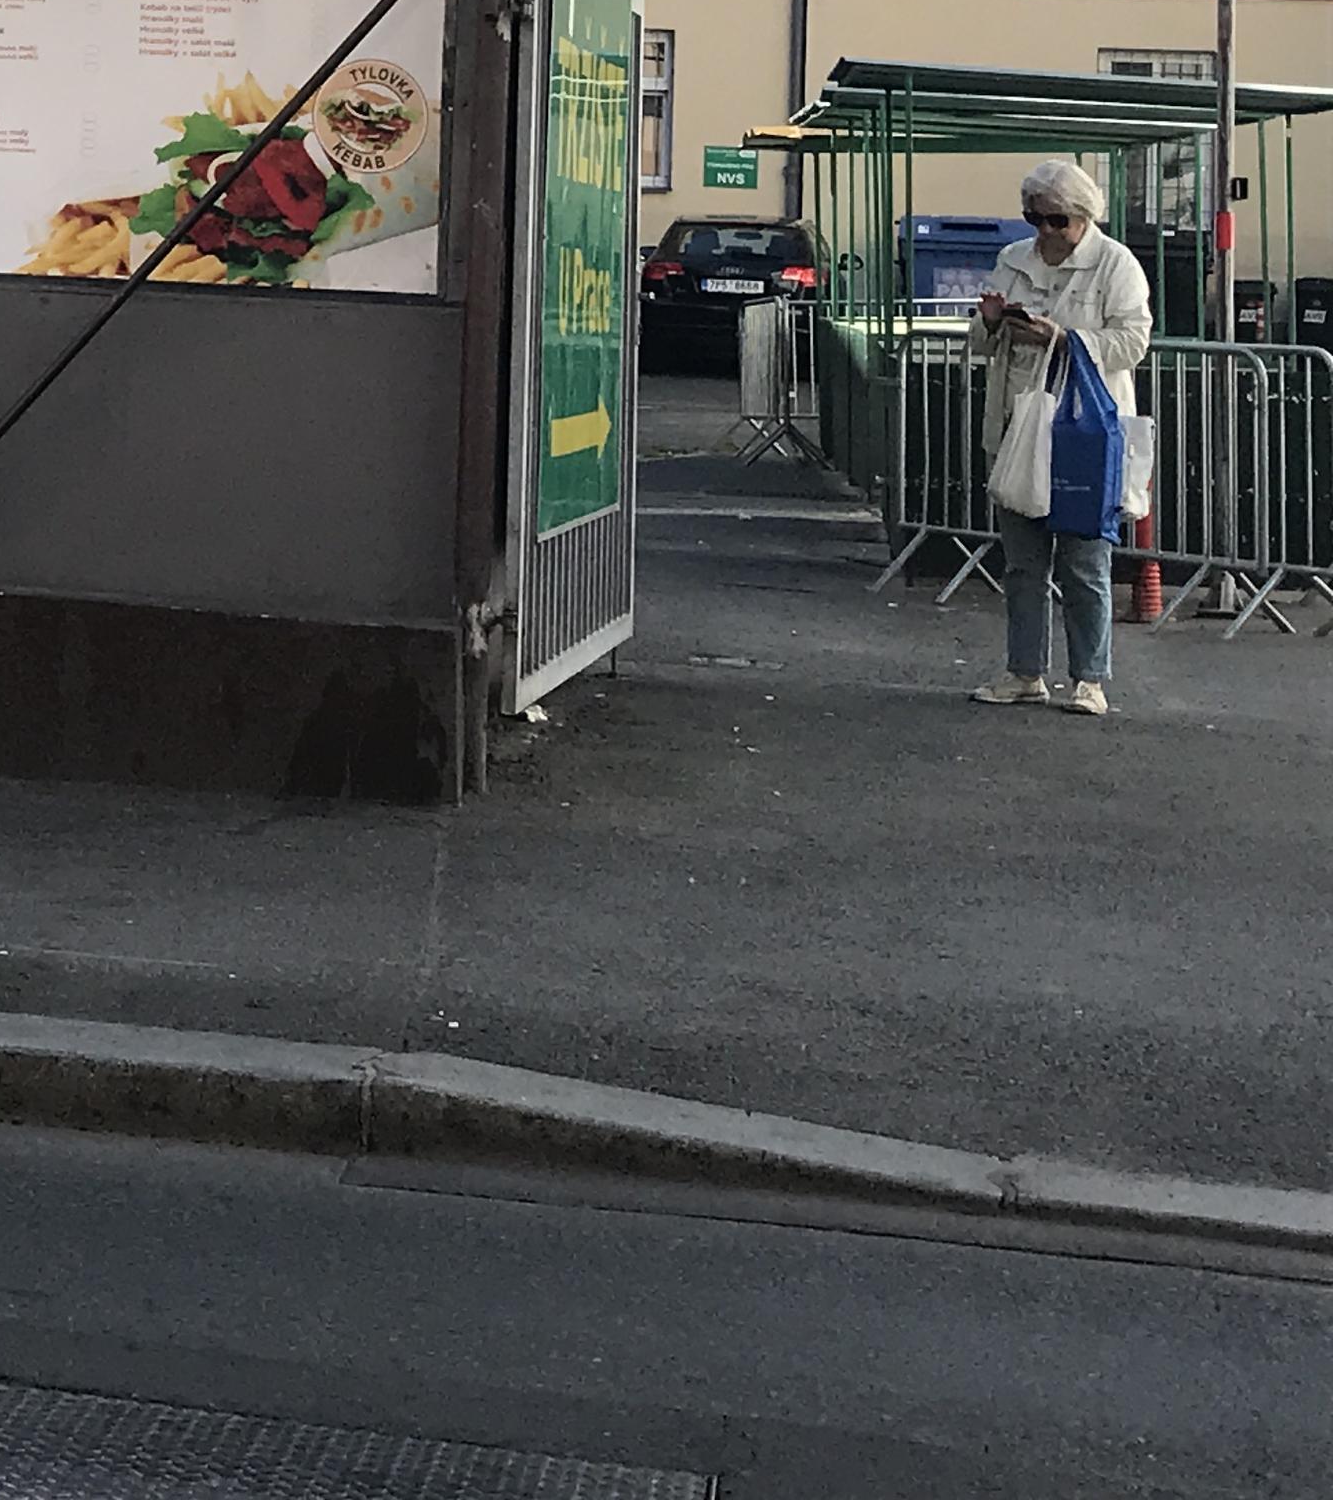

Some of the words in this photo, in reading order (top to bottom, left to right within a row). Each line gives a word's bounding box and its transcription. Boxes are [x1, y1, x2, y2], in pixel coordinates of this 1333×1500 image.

[349, 67, 414, 99] TYLOVKA
[332, 142, 386, 169] KEBAB
[717, 172, 745, 185] NVS
